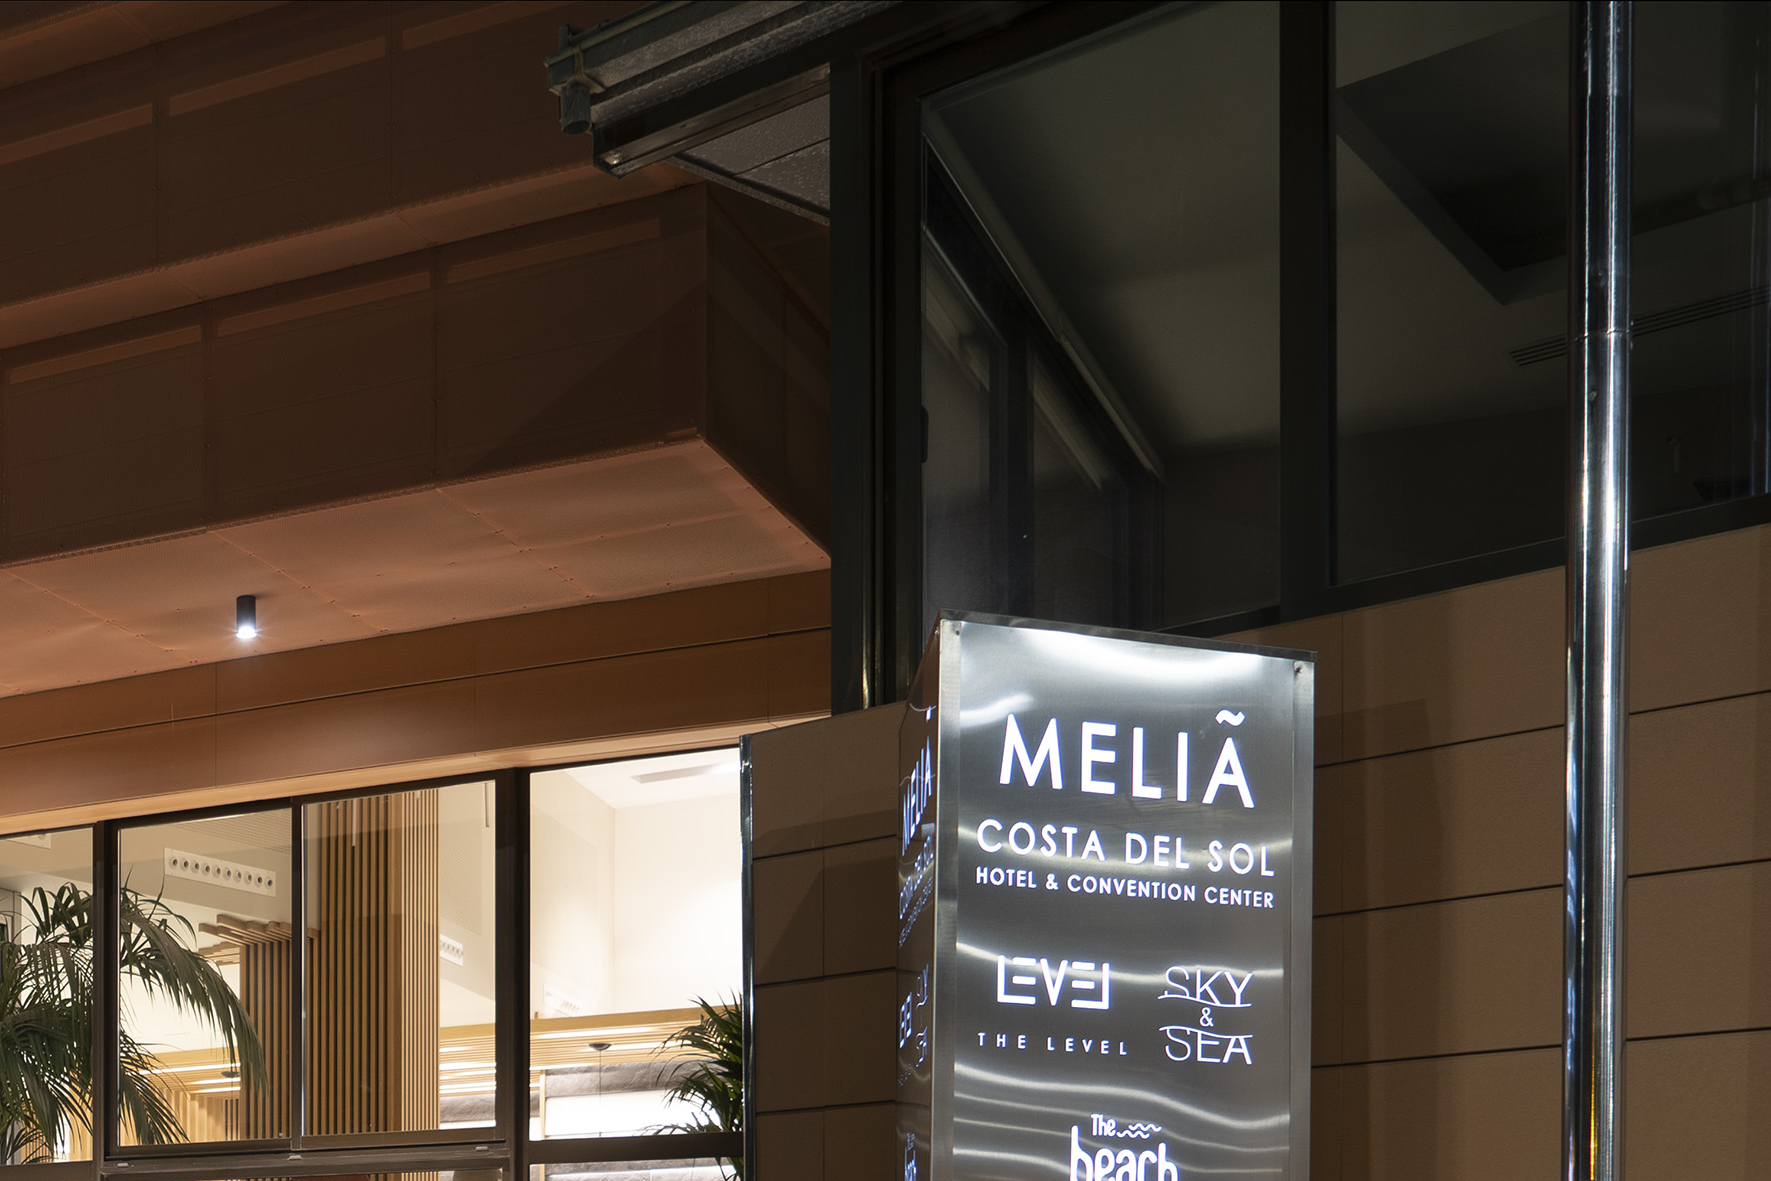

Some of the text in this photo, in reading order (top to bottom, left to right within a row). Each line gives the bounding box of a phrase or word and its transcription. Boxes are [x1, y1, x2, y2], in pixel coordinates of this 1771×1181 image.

[976, 818, 1276, 877] COSTA DEL SOL
[975, 866, 1275, 909] HOTEL & CONVENTION CENTER
[1157, 965, 1254, 1008] SKY
[1199, 1006, 1215, 1028] &
[976, 1031, 1128, 1056] THE LEVEL
[1157, 1024, 1254, 1065] SEA
[1090, 1112, 1117, 1137] The
